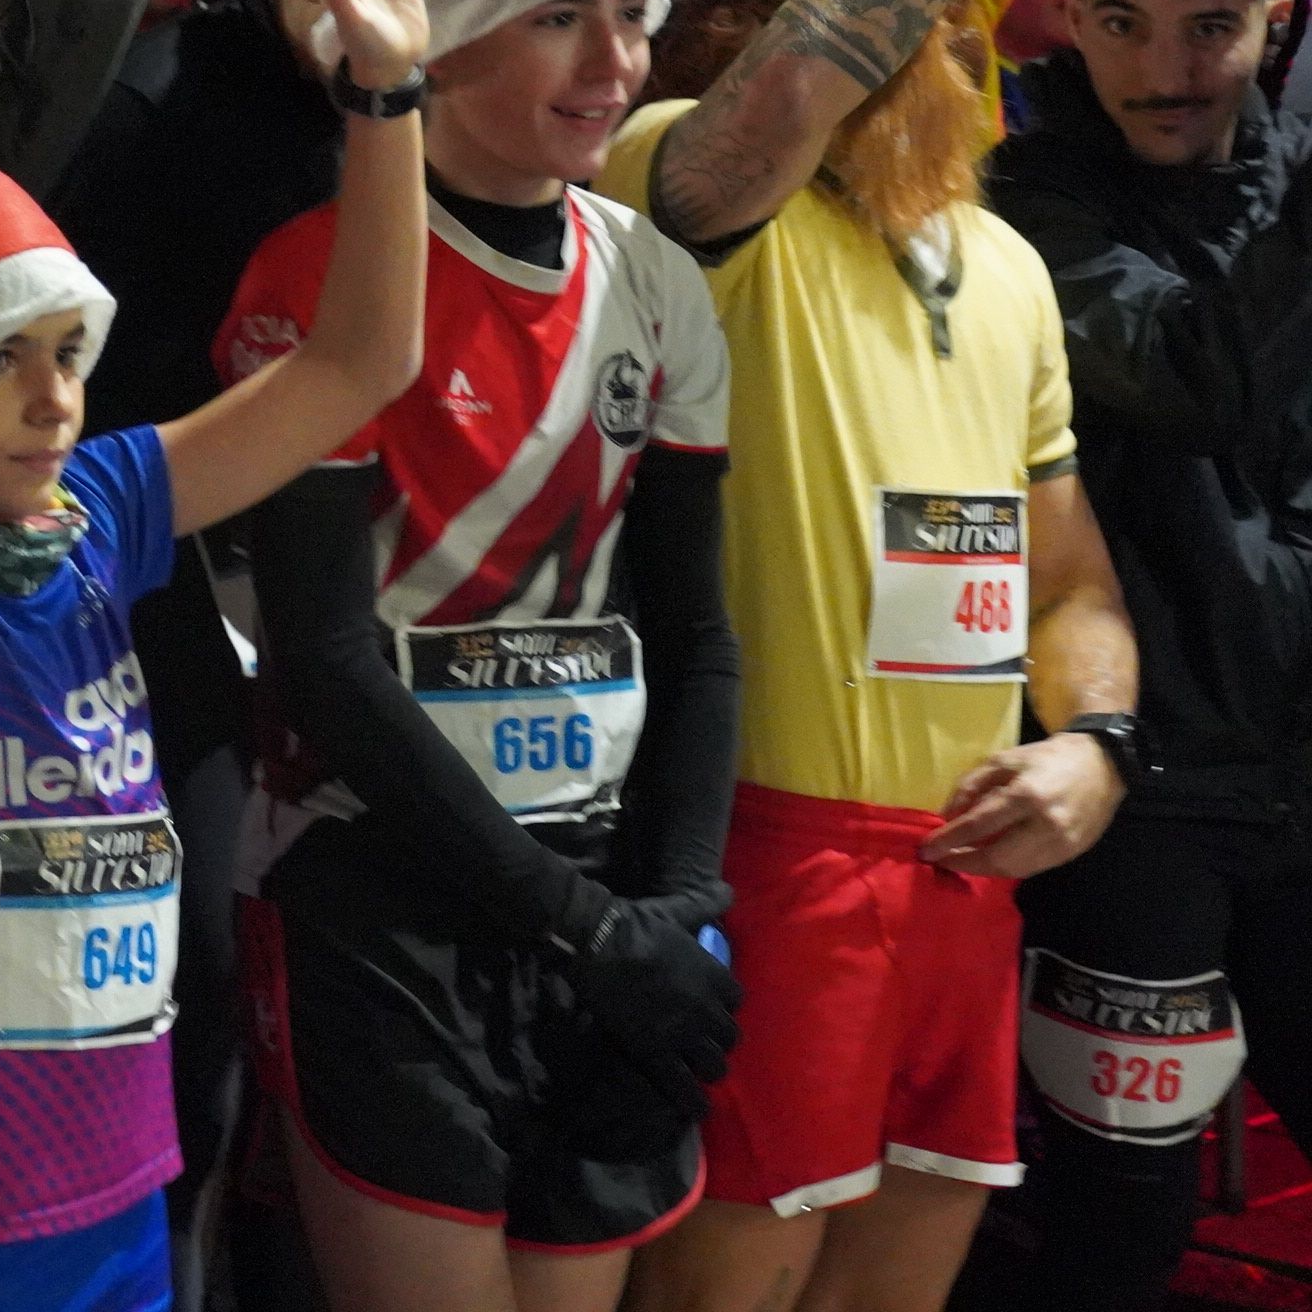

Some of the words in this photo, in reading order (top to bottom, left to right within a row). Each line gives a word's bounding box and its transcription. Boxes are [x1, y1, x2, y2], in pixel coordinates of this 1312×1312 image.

[493, 713, 593, 774] 656
[83, 921, 156, 991] 649
[1091, 1049, 1183, 1104] 326
